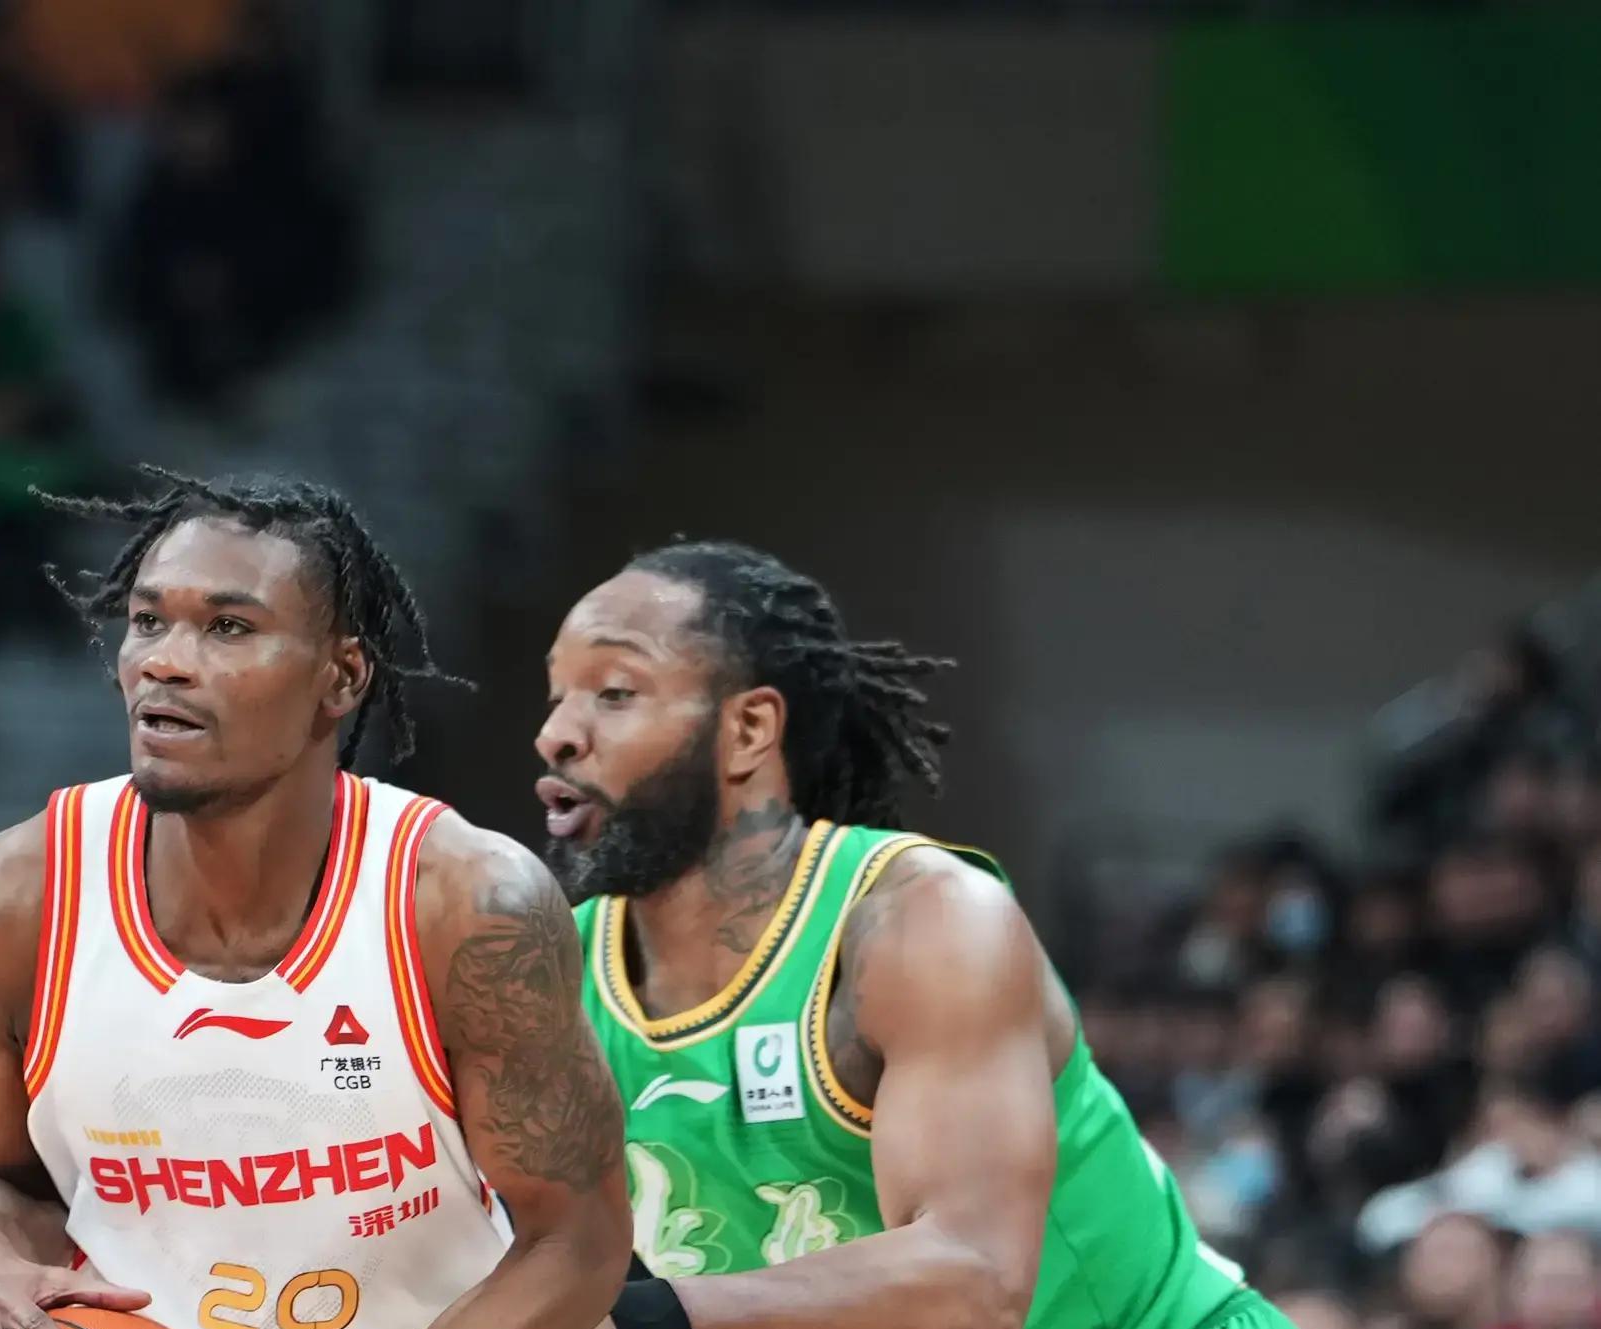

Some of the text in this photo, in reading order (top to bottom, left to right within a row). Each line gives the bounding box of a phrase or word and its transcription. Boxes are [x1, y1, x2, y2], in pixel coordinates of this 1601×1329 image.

[320, 1056, 381, 1071] 广发银行
[334, 1075, 371, 1090] CGB
[90, 1122, 436, 1215] SHENZHEN
[349, 1187, 440, 1237] 深圳
